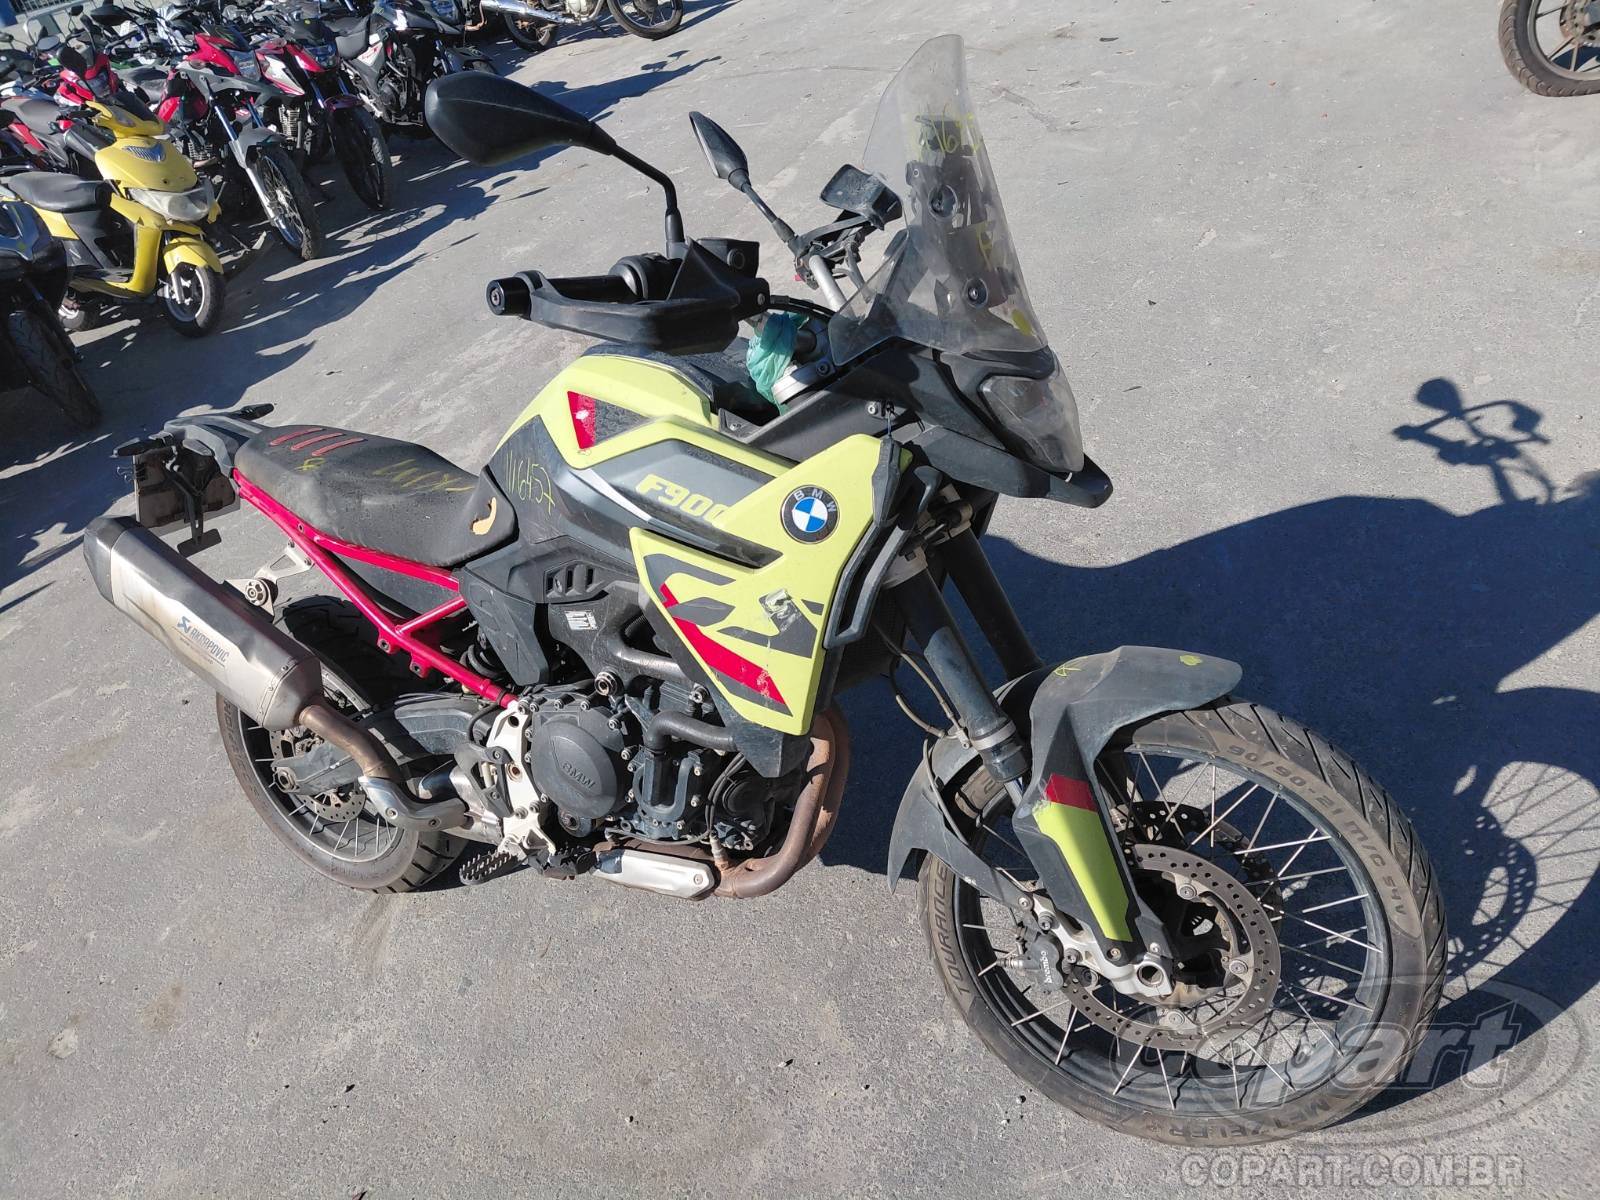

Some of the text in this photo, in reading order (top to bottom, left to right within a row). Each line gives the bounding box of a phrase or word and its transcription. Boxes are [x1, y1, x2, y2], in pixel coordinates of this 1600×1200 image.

[793, 488, 837, 512] BMW
[561, 762, 597, 790] BMW
[934, 862, 970, 996] TOURANCE
[1040, 950, 1053, 984] brembo
